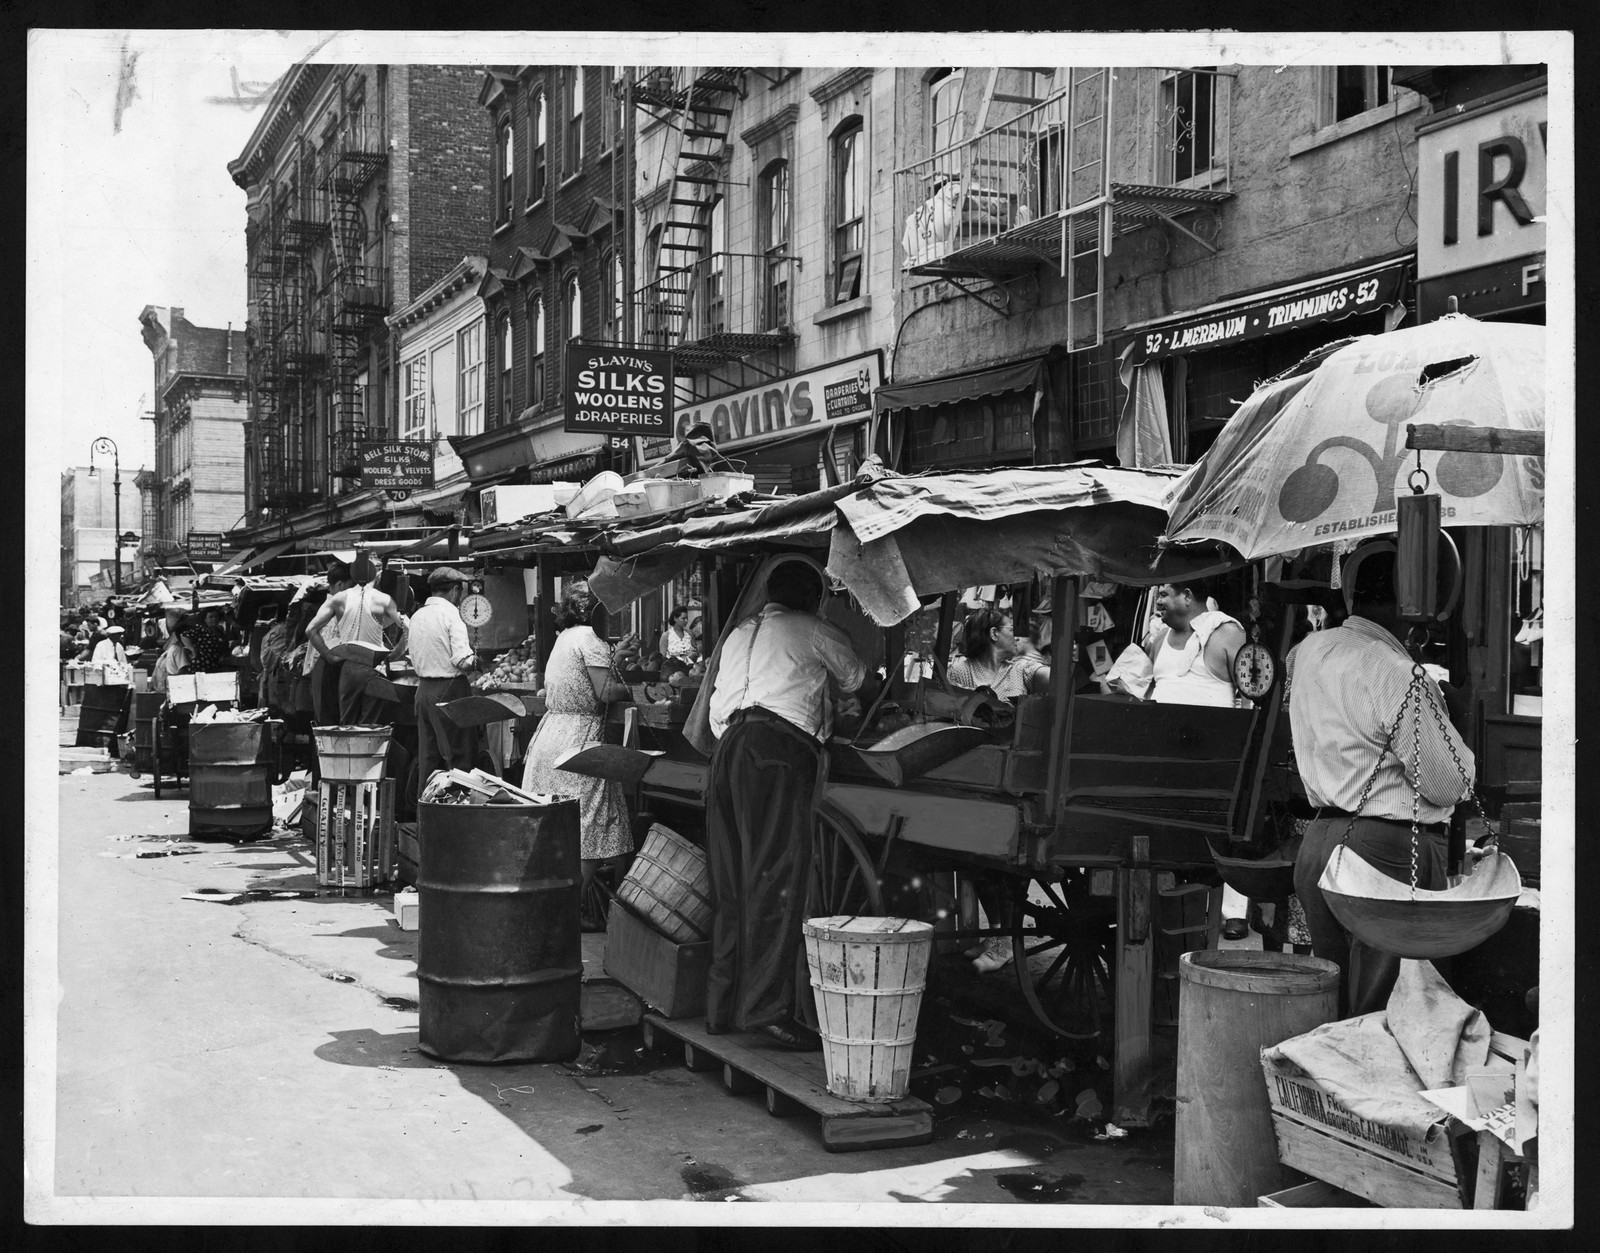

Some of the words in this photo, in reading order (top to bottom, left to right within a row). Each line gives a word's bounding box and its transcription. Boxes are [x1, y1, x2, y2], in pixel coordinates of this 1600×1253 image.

[1443, 121, 1547, 246] IR
[1146, 333, 1161, 354] 52
[1268, 287, 1348, 328] TRIMMINGS
[1356, 278, 1380, 304] 52
[588, 355, 653, 372] SLAVIN'S
[578, 370, 665, 393] SILKS
[859, 368, 871, 389] 54
[574, 391, 664, 410] WOOLENS
[825, 382, 859, 400] DRAPERIES
[611, 437, 629, 449] 54
[364, 448, 382, 462] BELL
[383, 445, 402, 454] SILK
[404, 446, 430, 462] STORE
[547, 461, 579, 478] BAKERY
[374, 478, 396, 486] DRESS
[398, 478, 423, 486] GOODS
[391, 490, 406, 500] 70
[1314, 513, 1399, 536] ESTABLISHE
[205, 541, 220, 550] MEATS
[320, 798, 328, 846] QUALITY
[1275, 1075, 1328, 1125] CALIFORNIA
[1326, 1111, 1361, 1137] GROWERS
